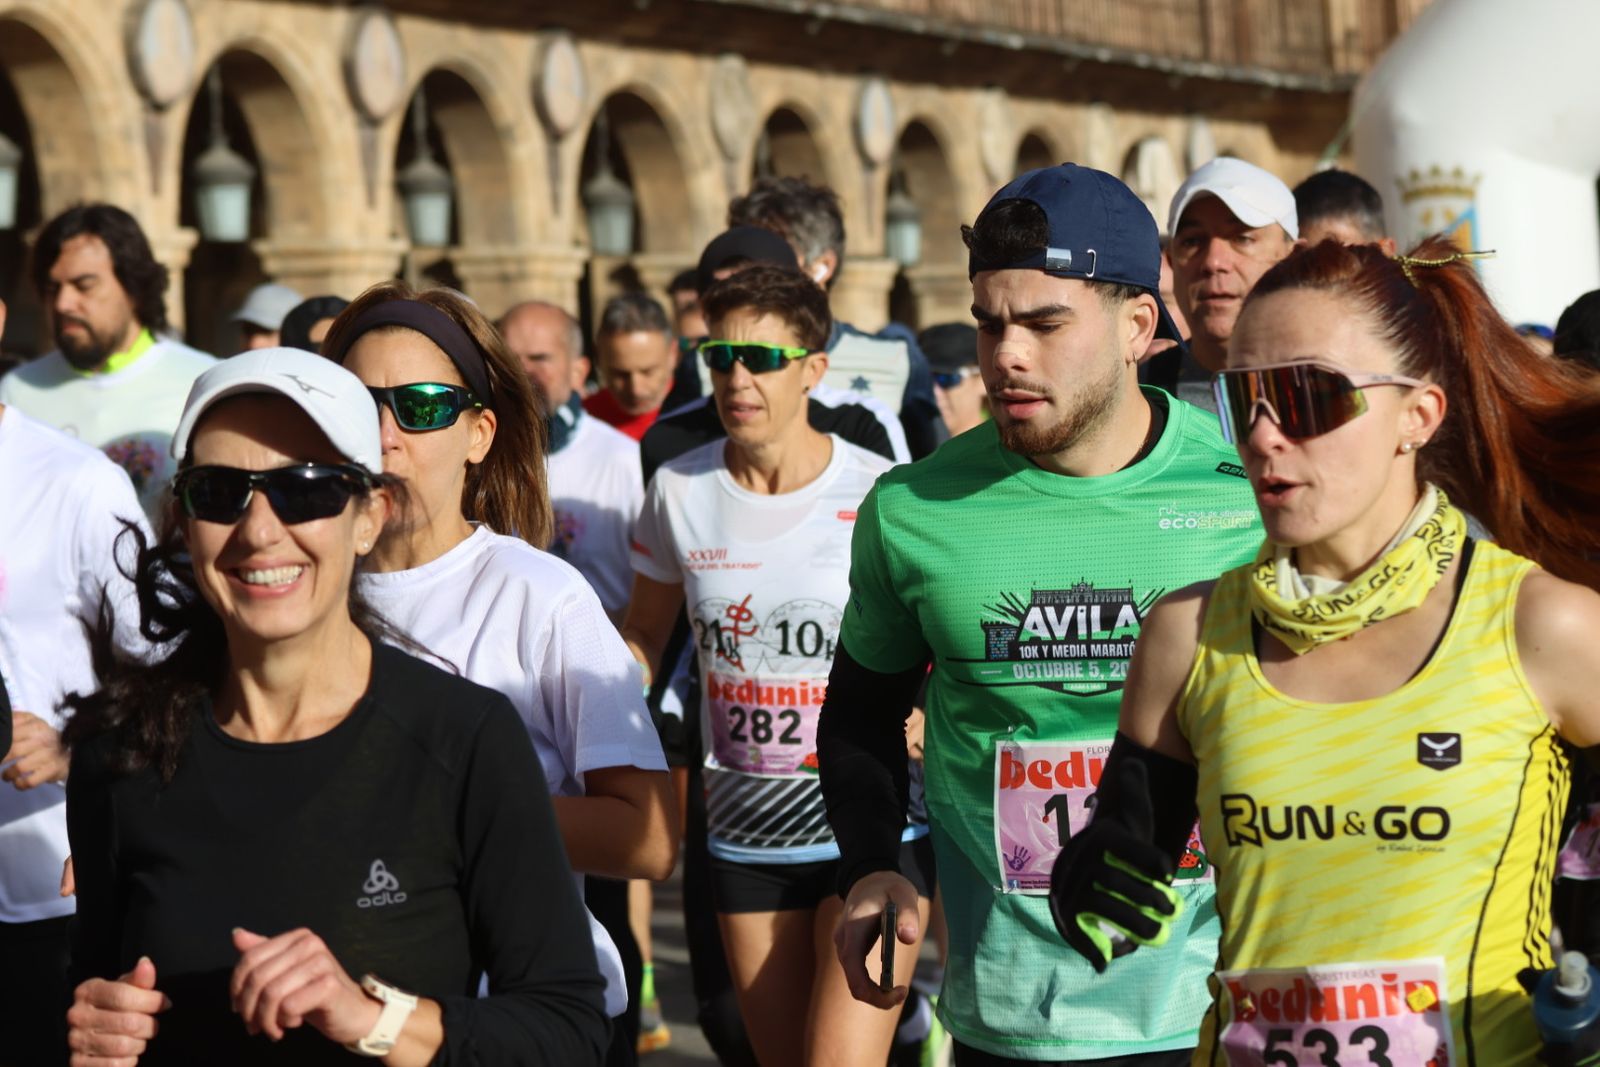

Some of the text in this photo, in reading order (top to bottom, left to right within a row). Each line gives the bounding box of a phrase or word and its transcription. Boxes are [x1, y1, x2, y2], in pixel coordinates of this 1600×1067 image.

[1019, 644, 1039, 659] 10K
[1042, 644, 1049, 658] Y
[1052, 643, 1088, 658] MEDIA
[1012, 661, 1084, 679] OCTUBRE
[1088, 661, 1104, 681] 5,
[728, 705, 802, 745] 282
[1220, 793, 1451, 848] RUN & GO
[356, 891, 408, 908] odlo
